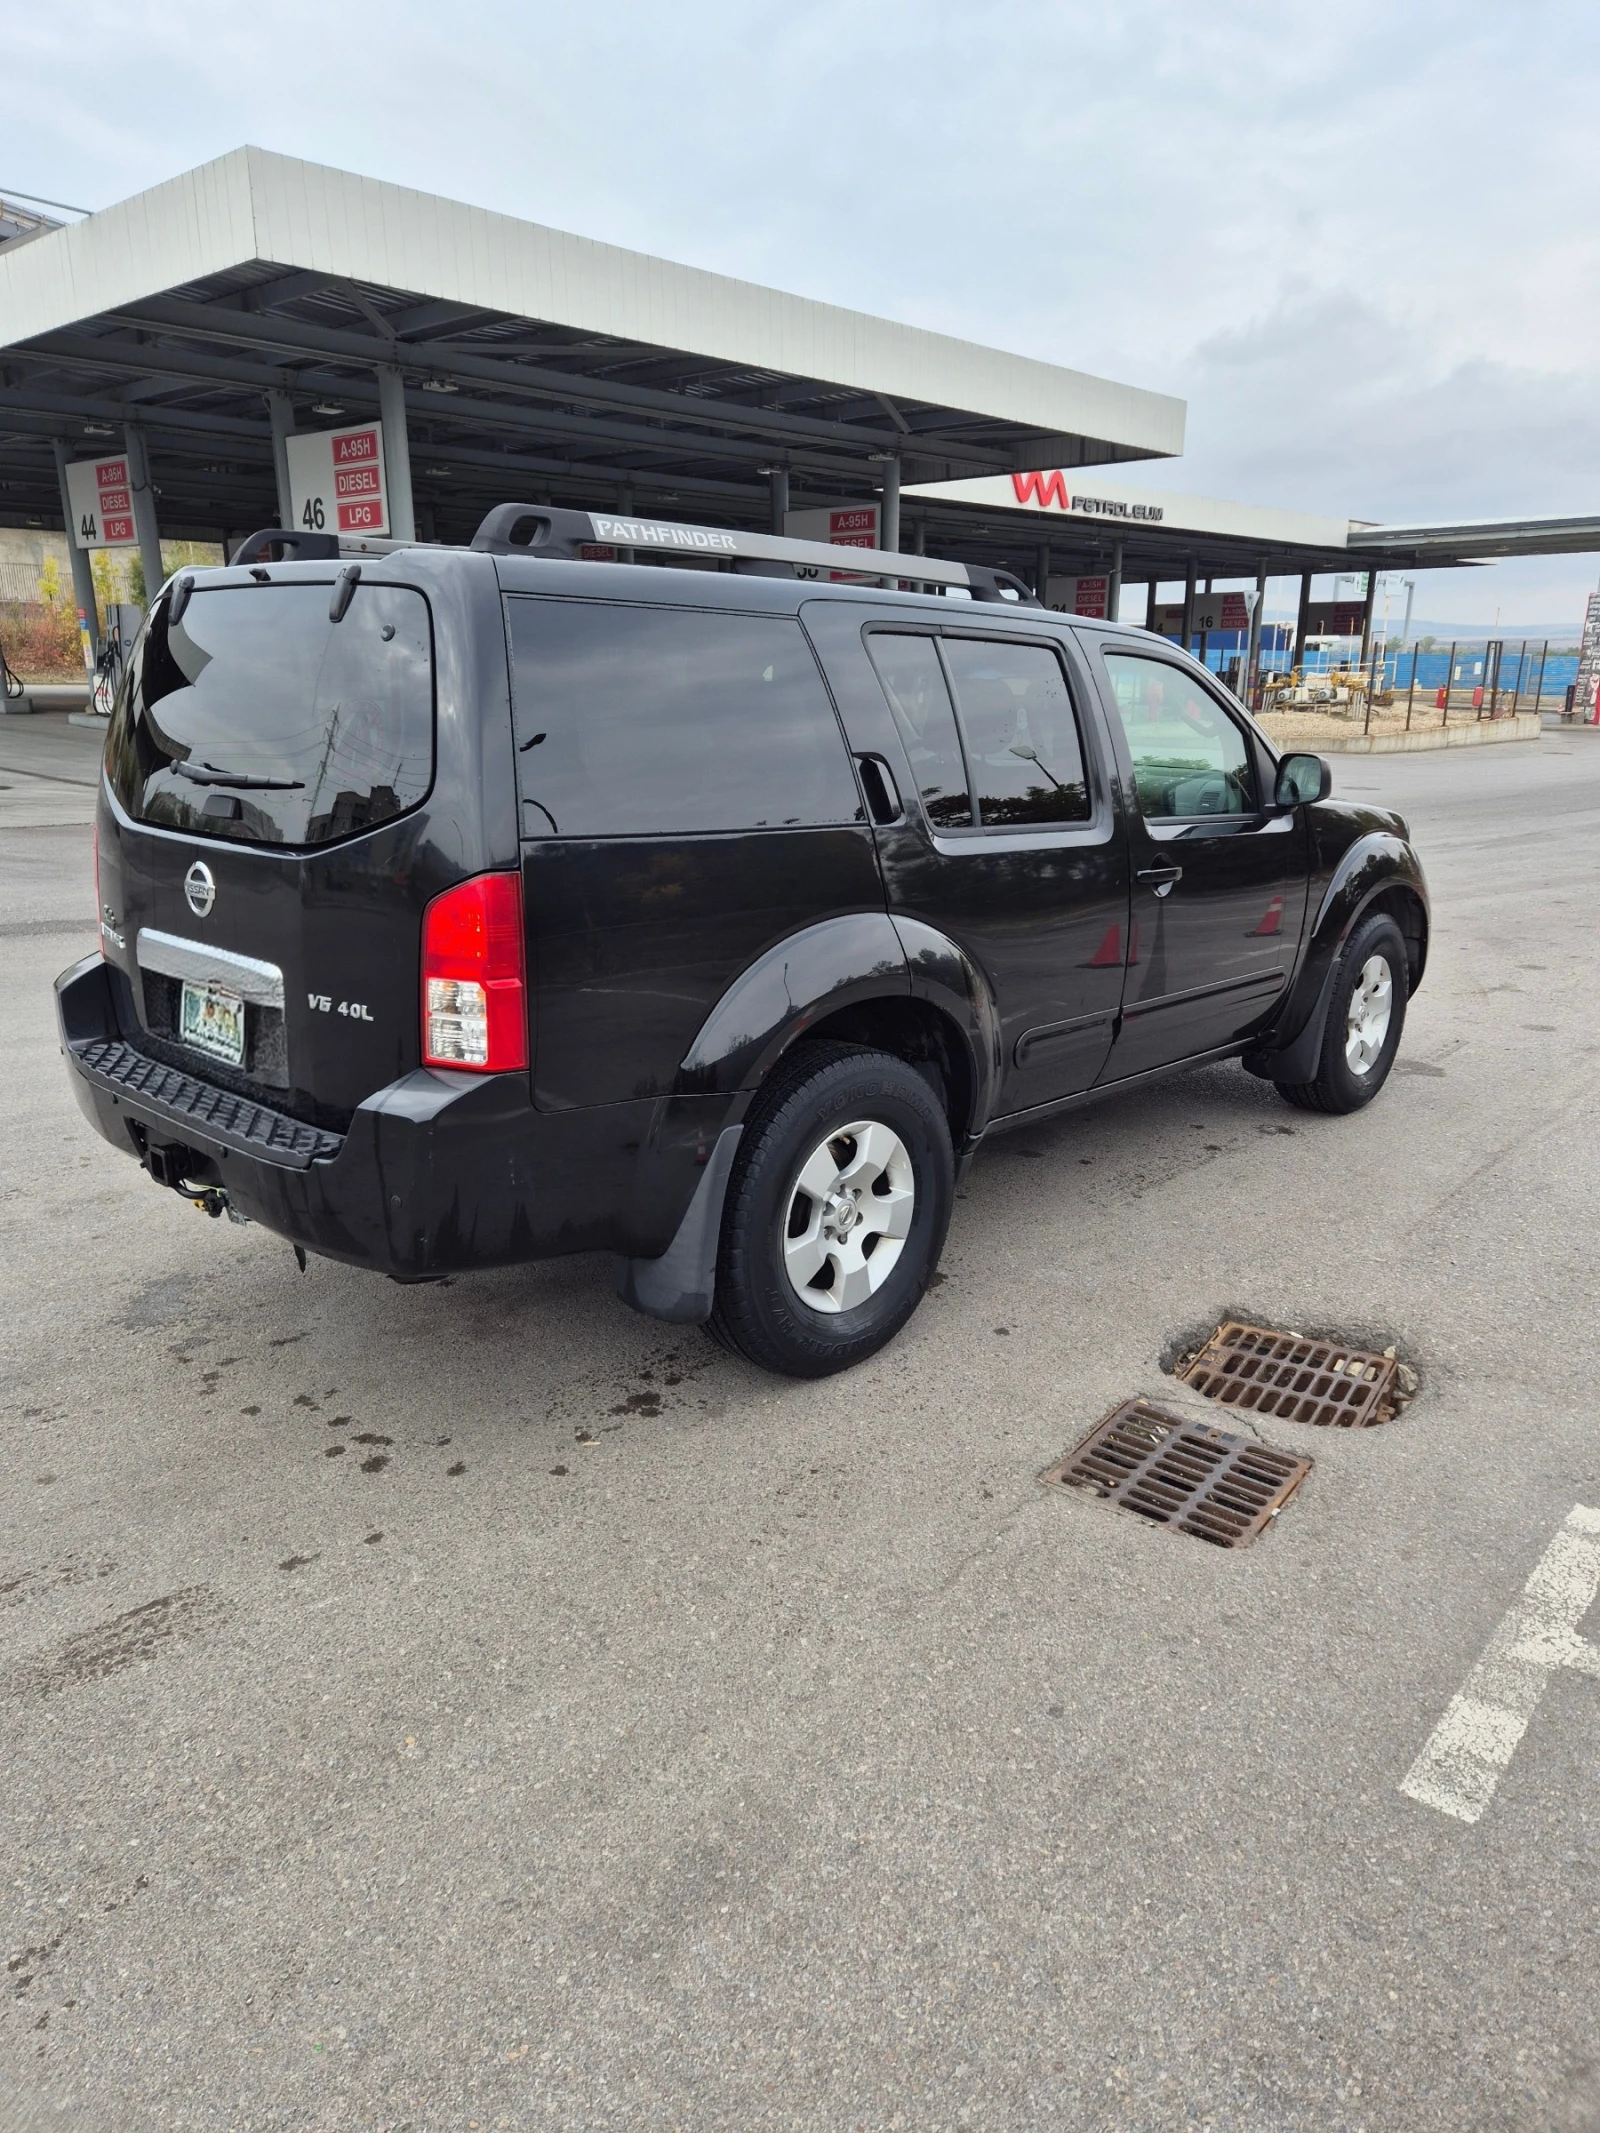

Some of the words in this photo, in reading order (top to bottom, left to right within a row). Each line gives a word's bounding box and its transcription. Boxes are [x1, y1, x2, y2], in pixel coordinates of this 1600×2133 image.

[341, 438, 371, 458] A-95H
[101, 467, 123, 483] A-95H
[338, 472, 377, 492] DIESEL
[102, 494, 128, 510] DIESEL
[1072, 496, 1163, 521] PETROLEUM
[302, 497, 325, 530] 46
[349, 507, 372, 524] LPG
[837, 514, 868, 529] A-95H
[81, 514, 97, 540] 44
[110, 522, 126, 536] LPG
[596, 520, 737, 549] PATHFINDER
[584, 547, 611, 558] DIESEL
[1078, 595, 1102, 603] DIESEL
[1082, 608, 1097, 616] LPG
[1156, 623, 1164, 633] 4
[1199, 616, 1214, 629] 16
[1222, 619, 1246, 627] DIESEL
[187, 884, 209, 896] SSAN
[816, 1080, 932, 1123] YOKOHAMA
